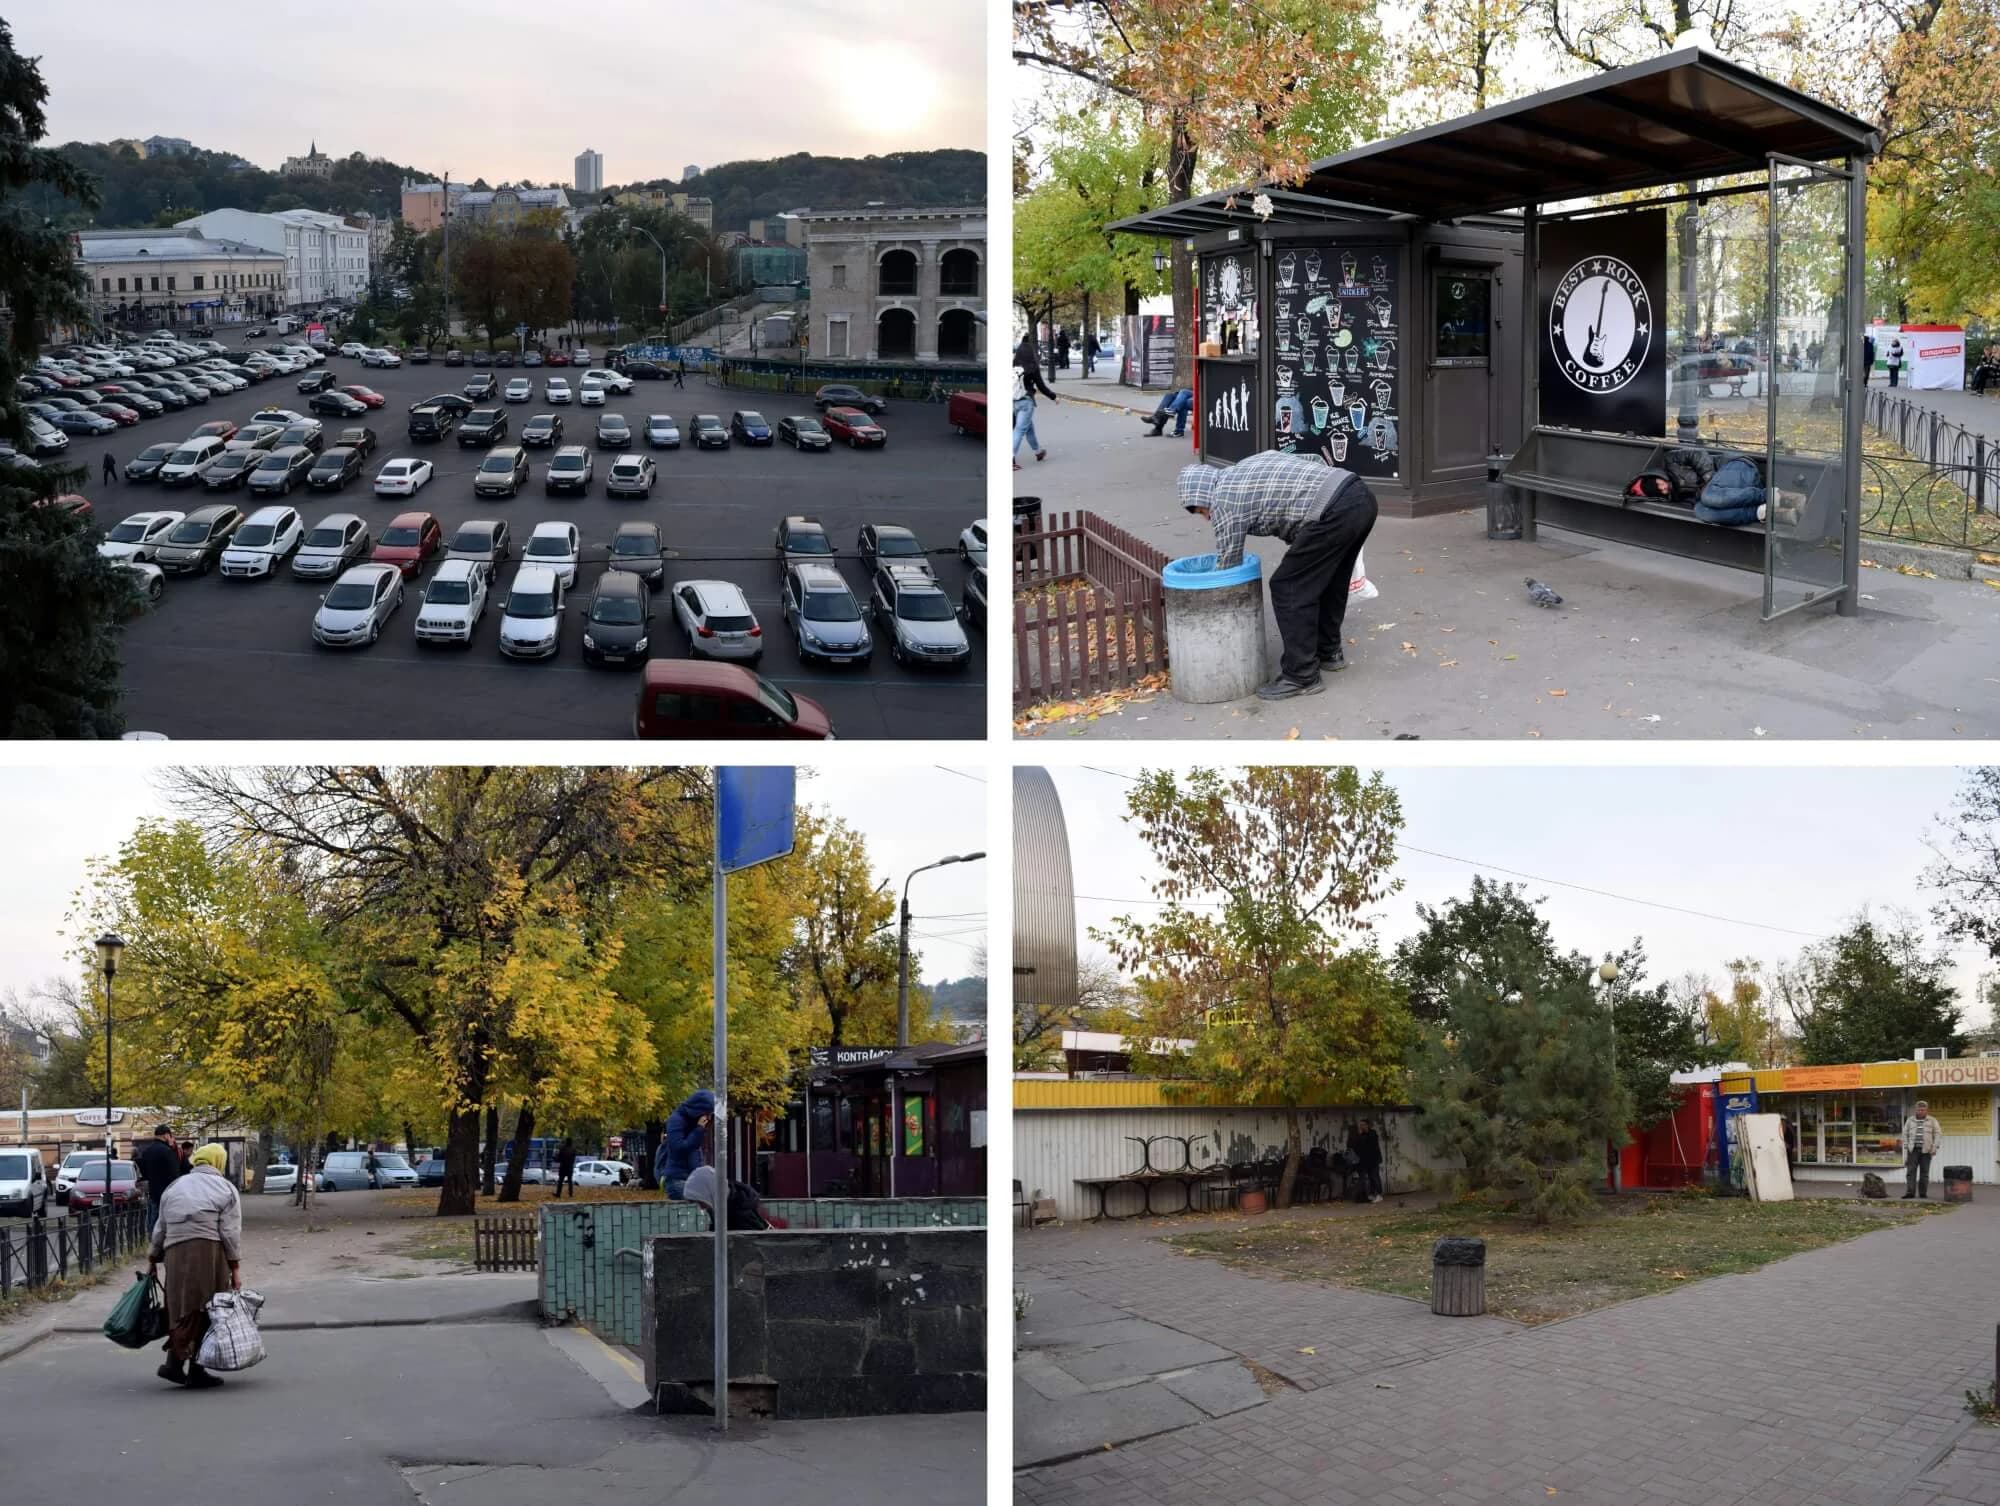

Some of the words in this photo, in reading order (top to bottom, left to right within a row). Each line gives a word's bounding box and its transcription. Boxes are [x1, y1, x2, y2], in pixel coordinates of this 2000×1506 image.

[1555, 264, 1587, 309] BEST
[1605, 260, 1646, 308] ROCK
[1565, 359, 1636, 388] COFFEE
[1920, 1066, 2000, 1084] КЛЮЧІВ
